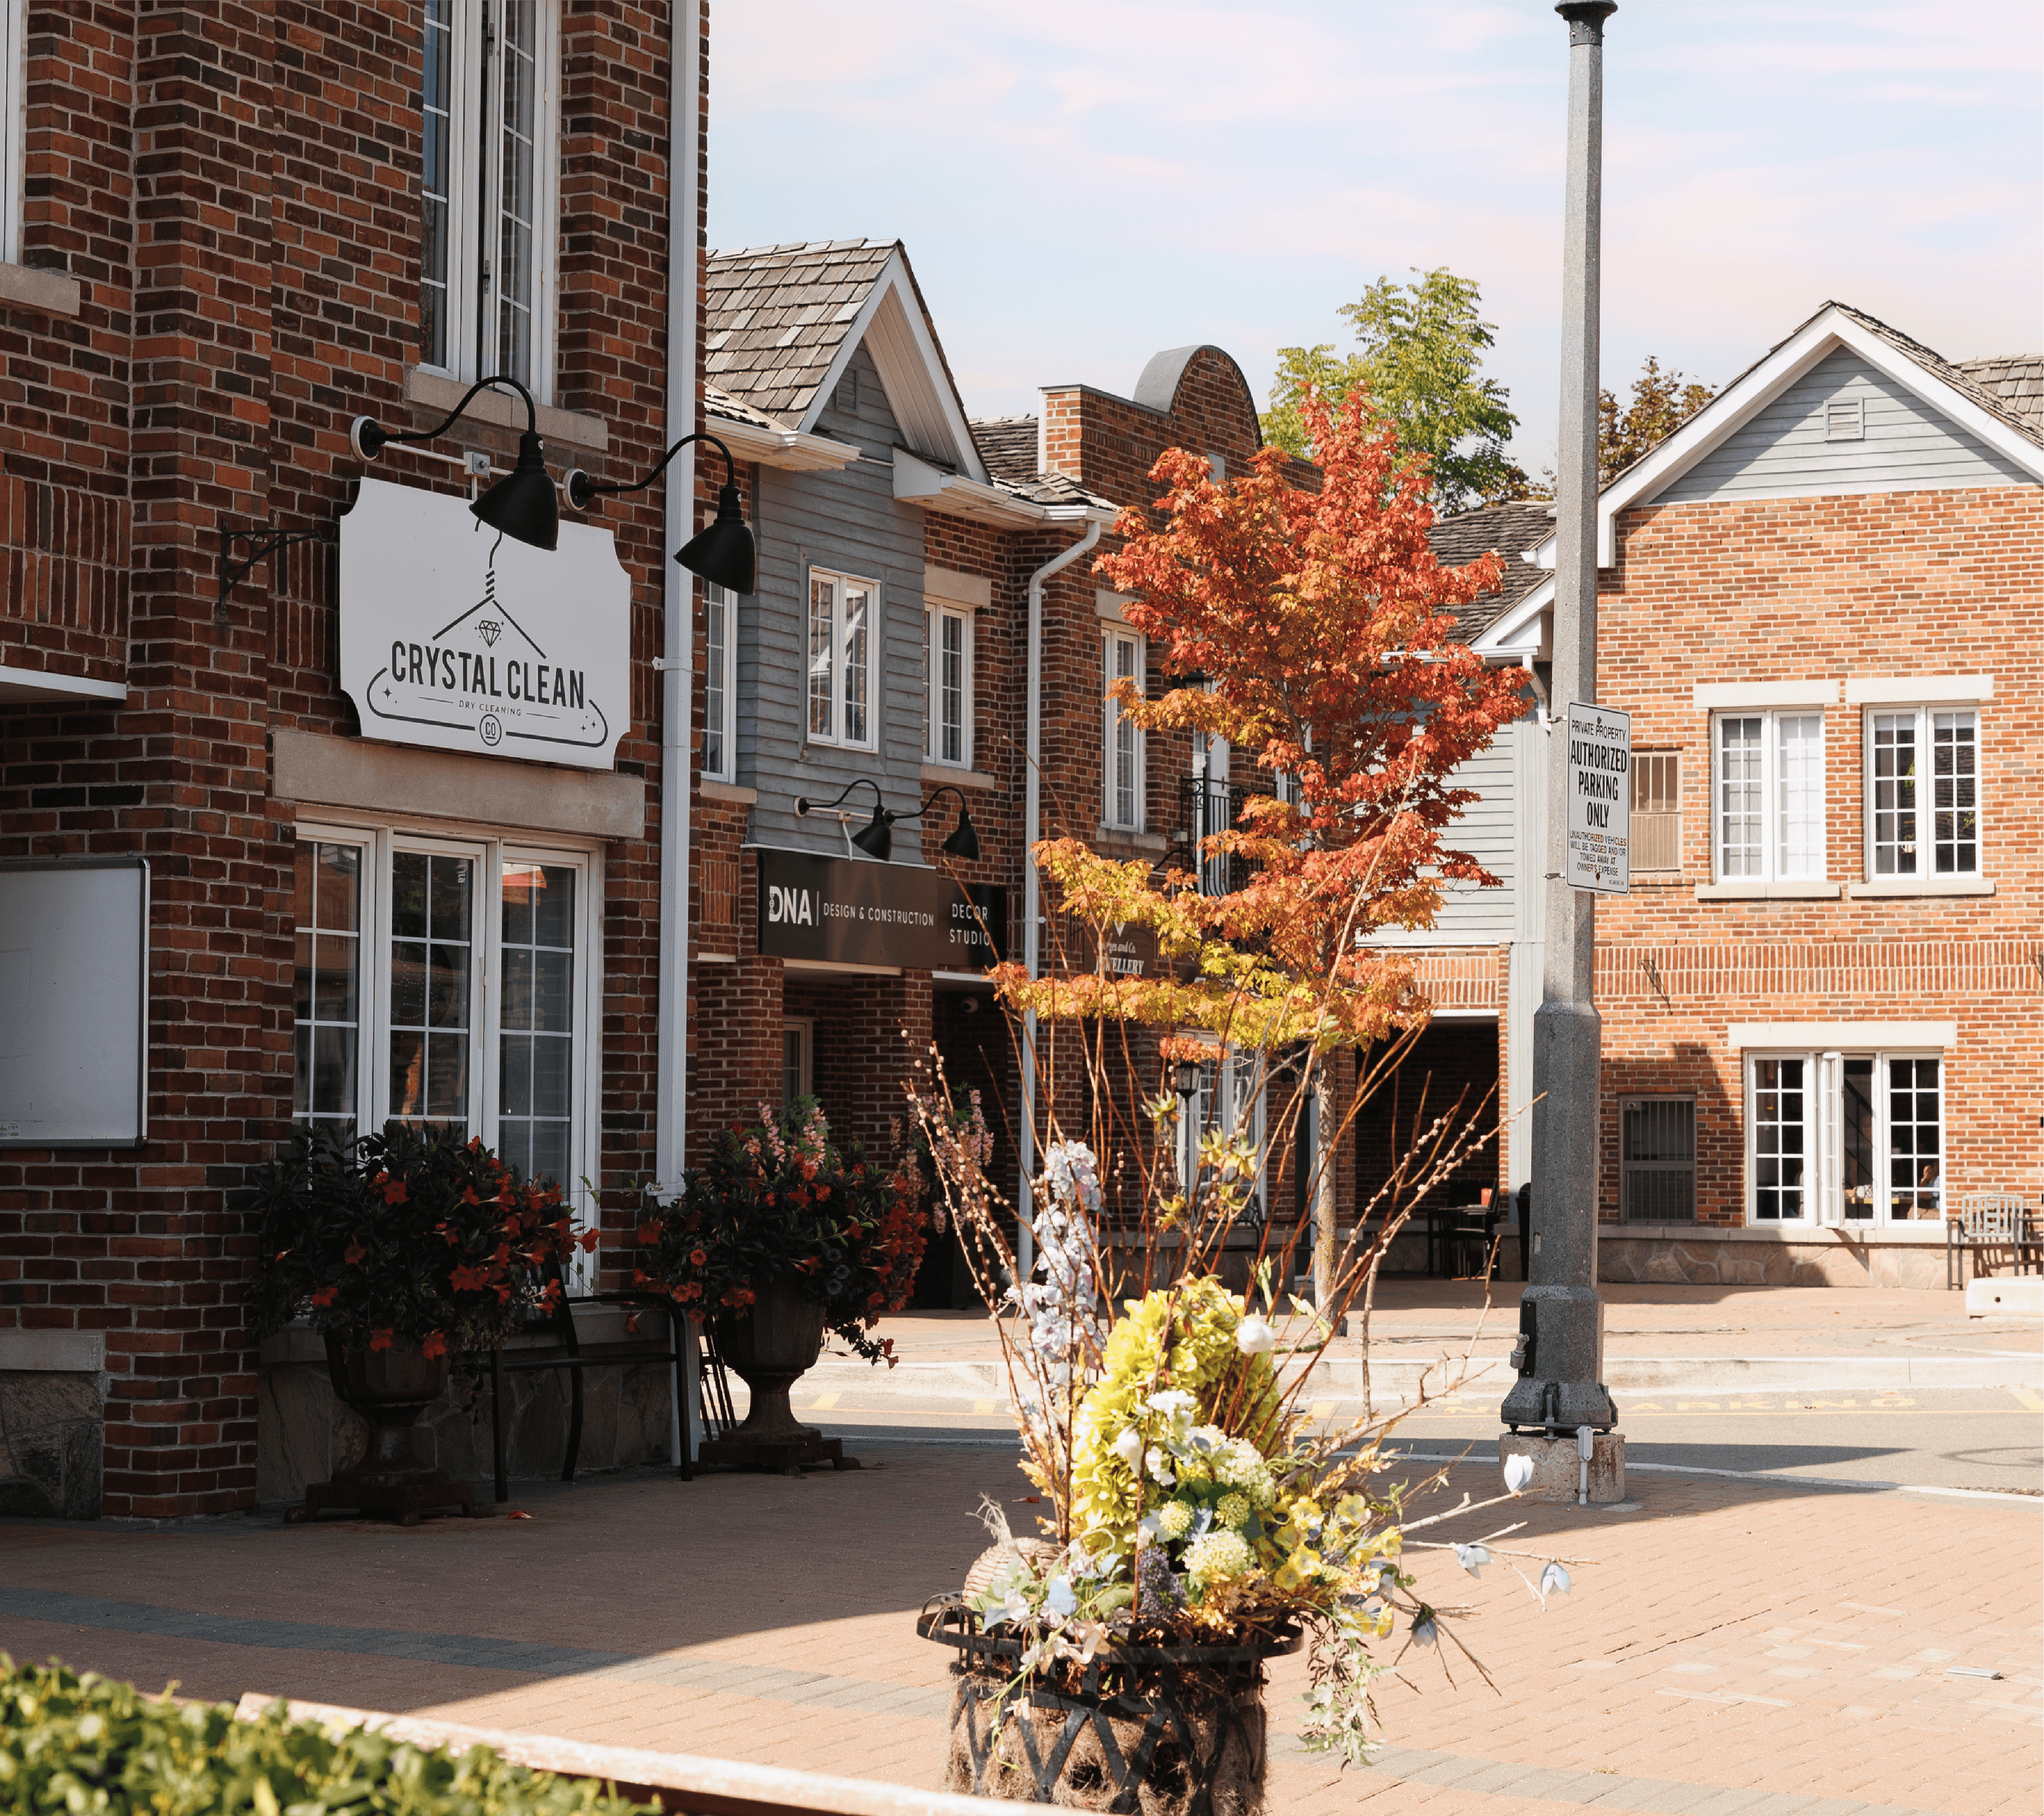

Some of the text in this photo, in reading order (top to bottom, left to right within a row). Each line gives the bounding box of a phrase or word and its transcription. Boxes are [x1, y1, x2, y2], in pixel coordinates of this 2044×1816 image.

[392, 641, 584, 709] CRYSTAL CLEAN
[459, 700, 521, 716] DRY CLEANING
[1572, 719, 1626, 741] PRIVATE PROPERTY
[1571, 740, 1627, 772] AUTHORIZED
[1578, 770, 1618, 800] PARKING
[1587, 802, 1609, 828] ONLY
[1570, 830, 1626, 846] UNAUTHORIZED VEHICLES
[1570, 840, 1581, 850] WILL
[1582, 842, 1588, 851] BE
[1590, 843, 1607, 853] TAGGED
[1579, 852, 1616, 865] TOWED AWAY AT
[1599, 865, 1618, 876] EXPENSE
[768, 885, 812, 925] DNA
[952, 903, 987, 920] DECOR
[823, 903, 934, 926] DESIGN & CONSTRUCTION
[950, 929, 990, 945] STUDIO
[1093, 956, 1145, 974] JWELLERY
[1618, 1398, 1916, 1411] ARKING
